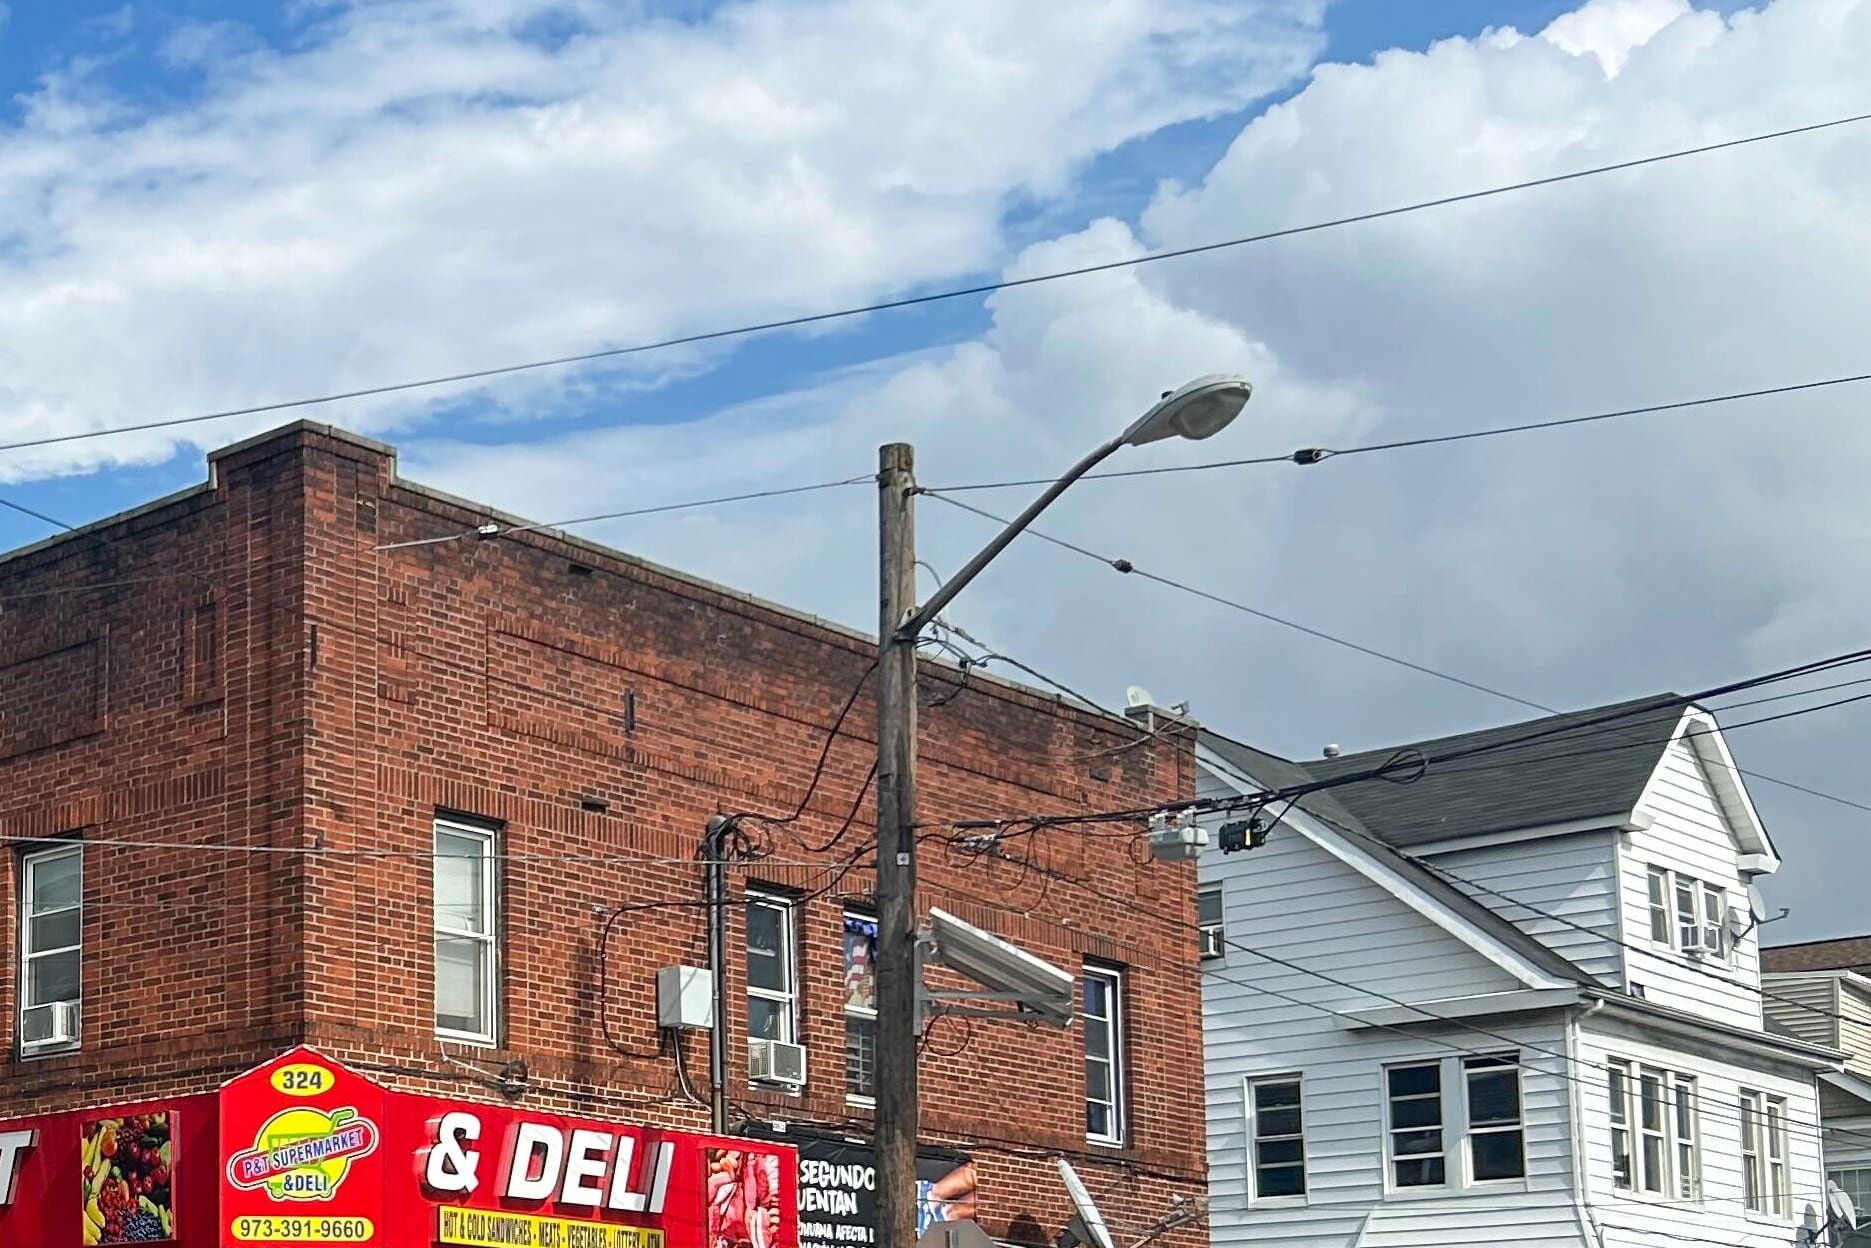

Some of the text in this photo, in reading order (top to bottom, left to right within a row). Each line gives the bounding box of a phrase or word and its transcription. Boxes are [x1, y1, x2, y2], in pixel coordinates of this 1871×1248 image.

[282, 1071, 322, 1090] 324
[243, 1126, 365, 1179] P&T SUPERMARKET
[428, 1111, 676, 1214] & DELI
[240, 1219, 365, 1239] 973-391-9660
[443, 1211, 458, 1239] HOT
[467, 1215, 485, 1241] COLD
[487, 1215, 532, 1246] SANDWICHES
[538, 1223, 561, 1248] MEATS
